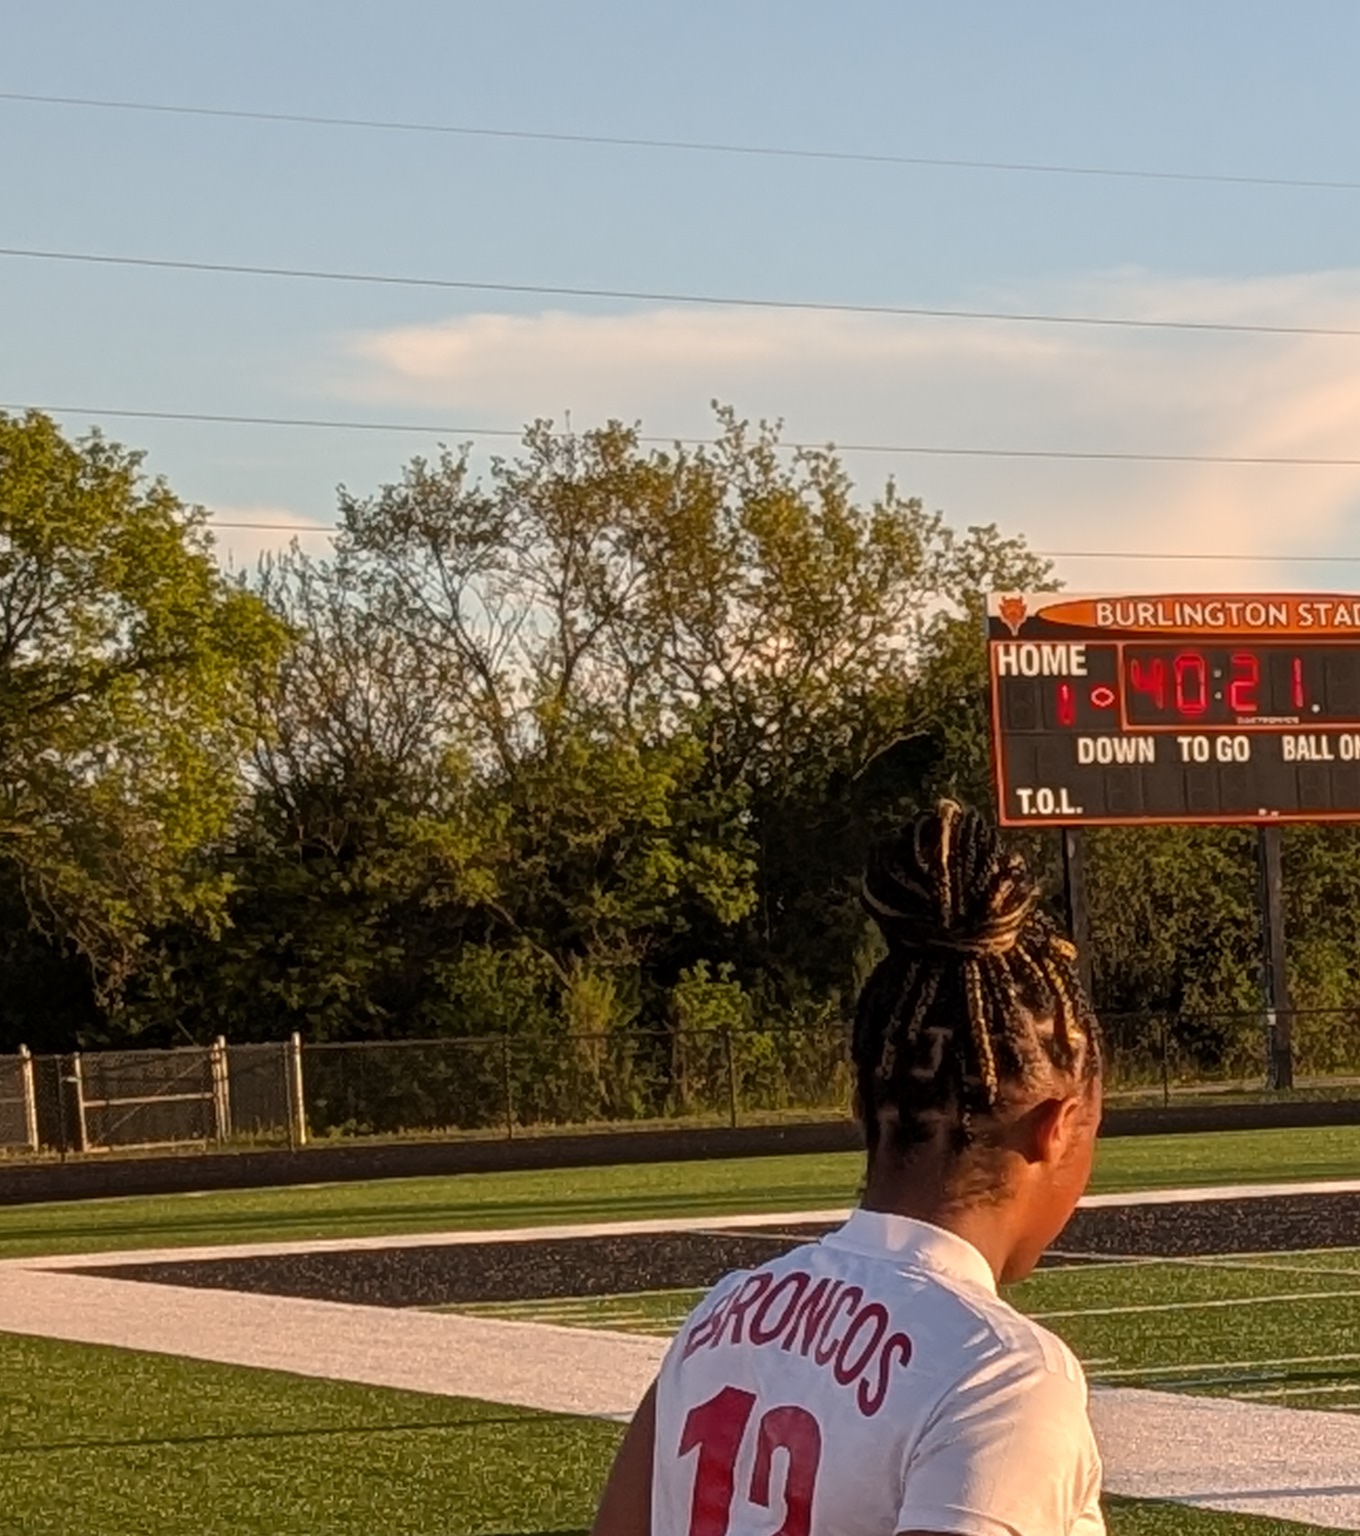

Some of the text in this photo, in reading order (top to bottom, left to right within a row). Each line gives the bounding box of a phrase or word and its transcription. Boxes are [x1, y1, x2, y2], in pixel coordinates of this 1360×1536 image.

[1097, 602, 1287, 627] BURLINGTON
[998, 645, 1088, 676] HOME
[1078, 737, 1155, 764] DOWN
[1177, 735, 1250, 762] TO GO
[1282, 734, 1334, 762] BALL
[1016, 788, 1083, 815] T.O.L.
[682, 1271, 913, 1417] BRONCOS
